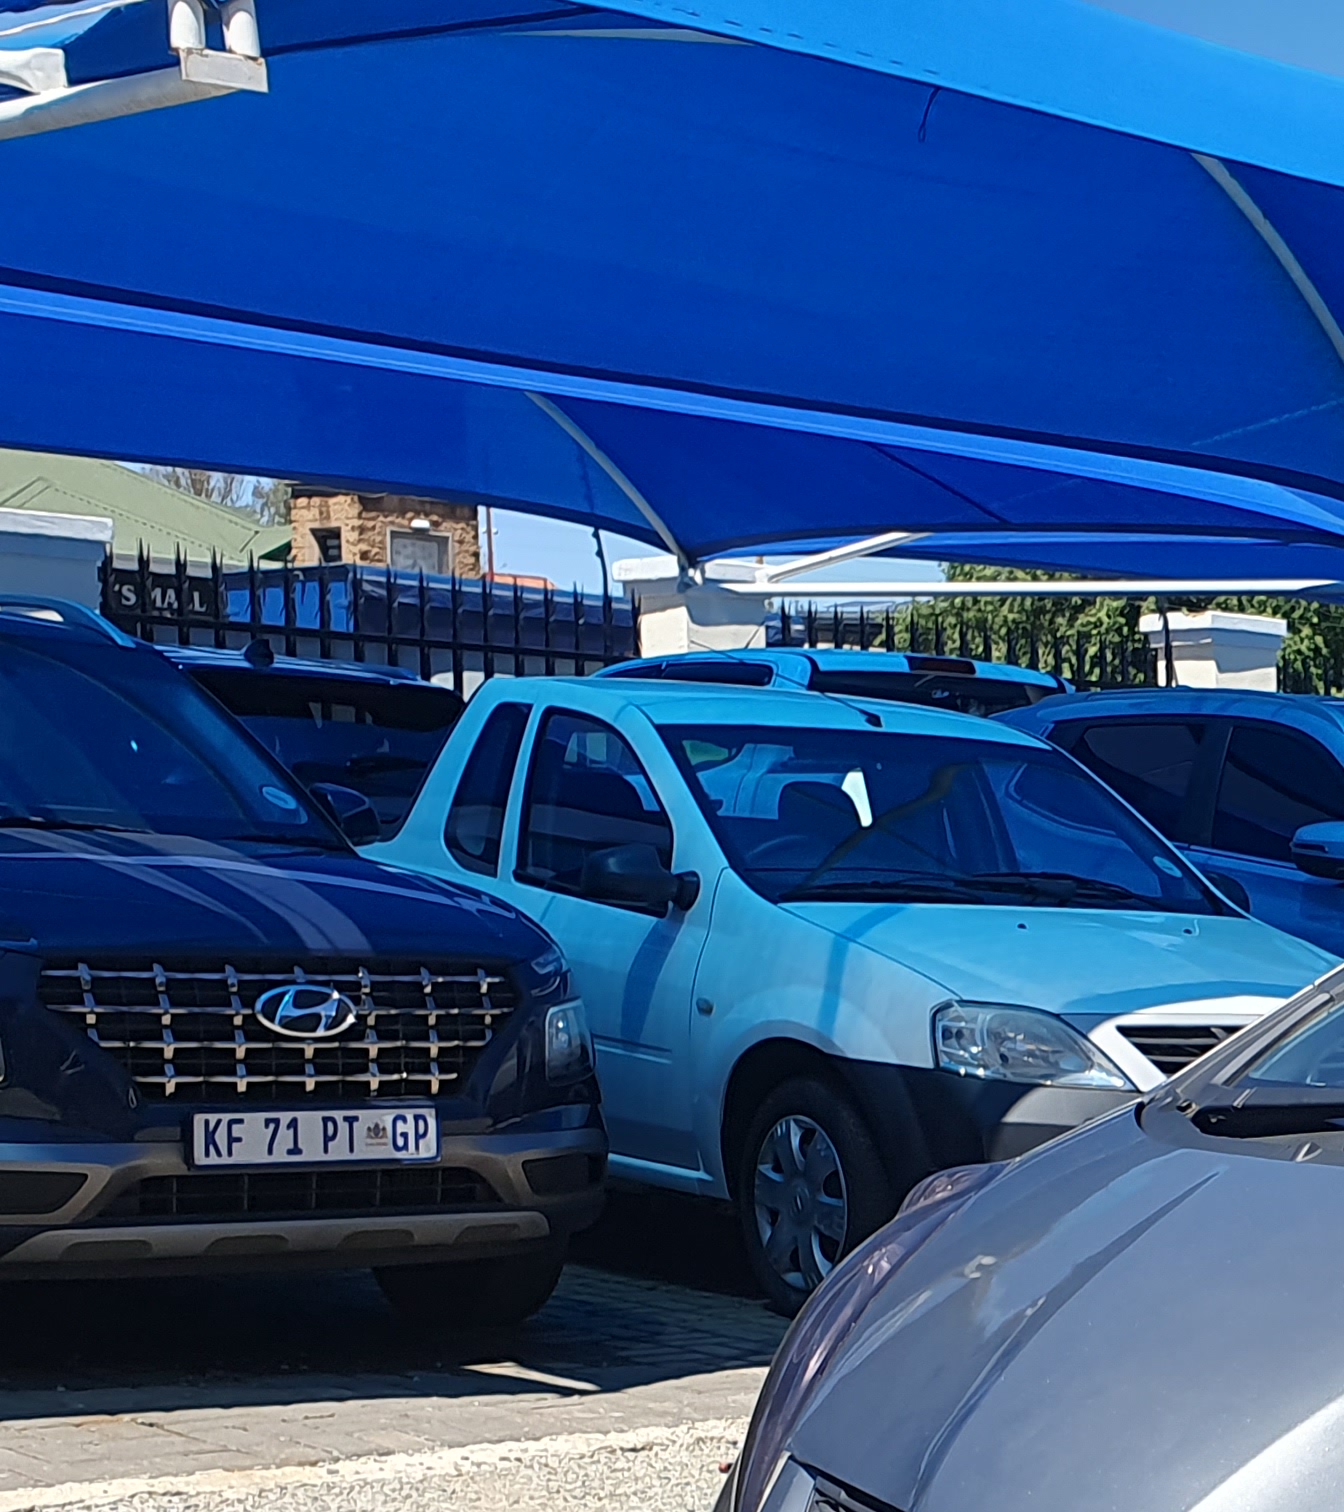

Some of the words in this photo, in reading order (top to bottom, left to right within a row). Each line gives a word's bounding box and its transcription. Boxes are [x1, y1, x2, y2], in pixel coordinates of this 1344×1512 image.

[204, 1118, 245, 1158] KF
[264, 1116, 303, 1156] 71
[321, 1115, 360, 1154] PT
[392, 1114, 430, 1155] GP
